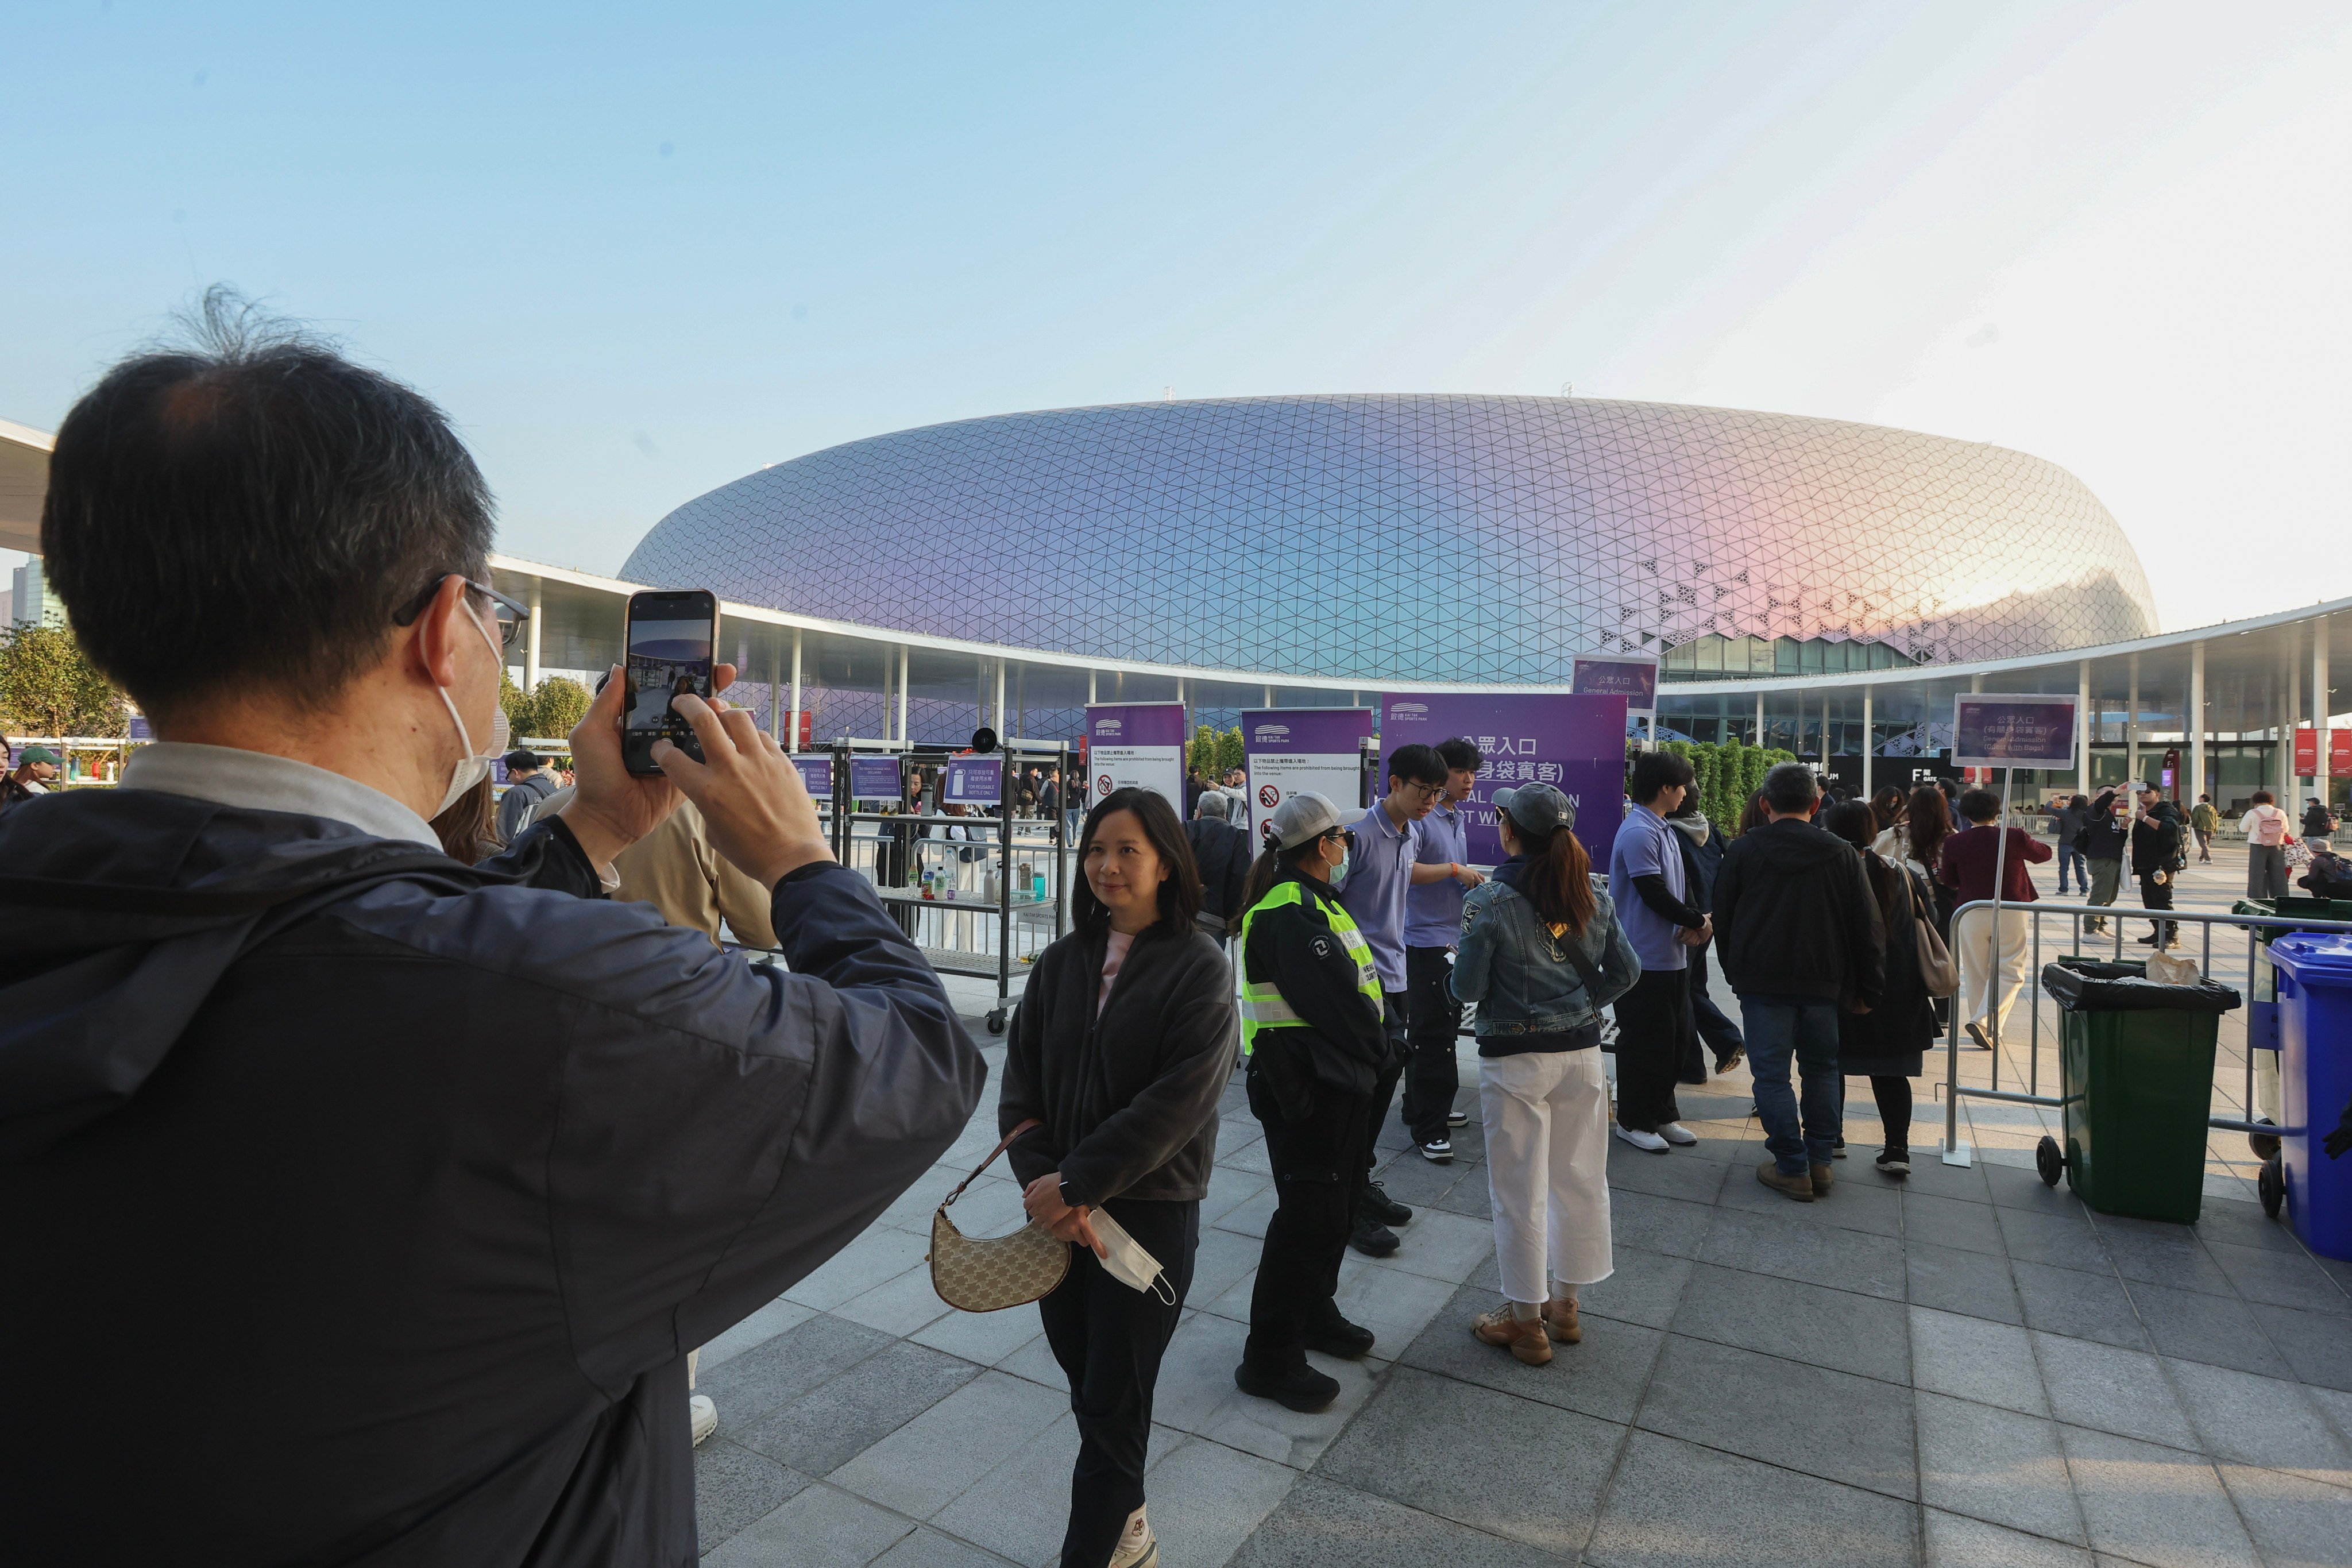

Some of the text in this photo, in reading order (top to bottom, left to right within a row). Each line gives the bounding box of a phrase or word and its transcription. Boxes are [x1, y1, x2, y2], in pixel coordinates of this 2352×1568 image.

[1598, 676, 1630, 685] 公眾入口
[1609, 688, 1643, 696] Admission
[1997, 716, 2034, 724] 公眾入口
[1913, 768, 1922, 781] F
